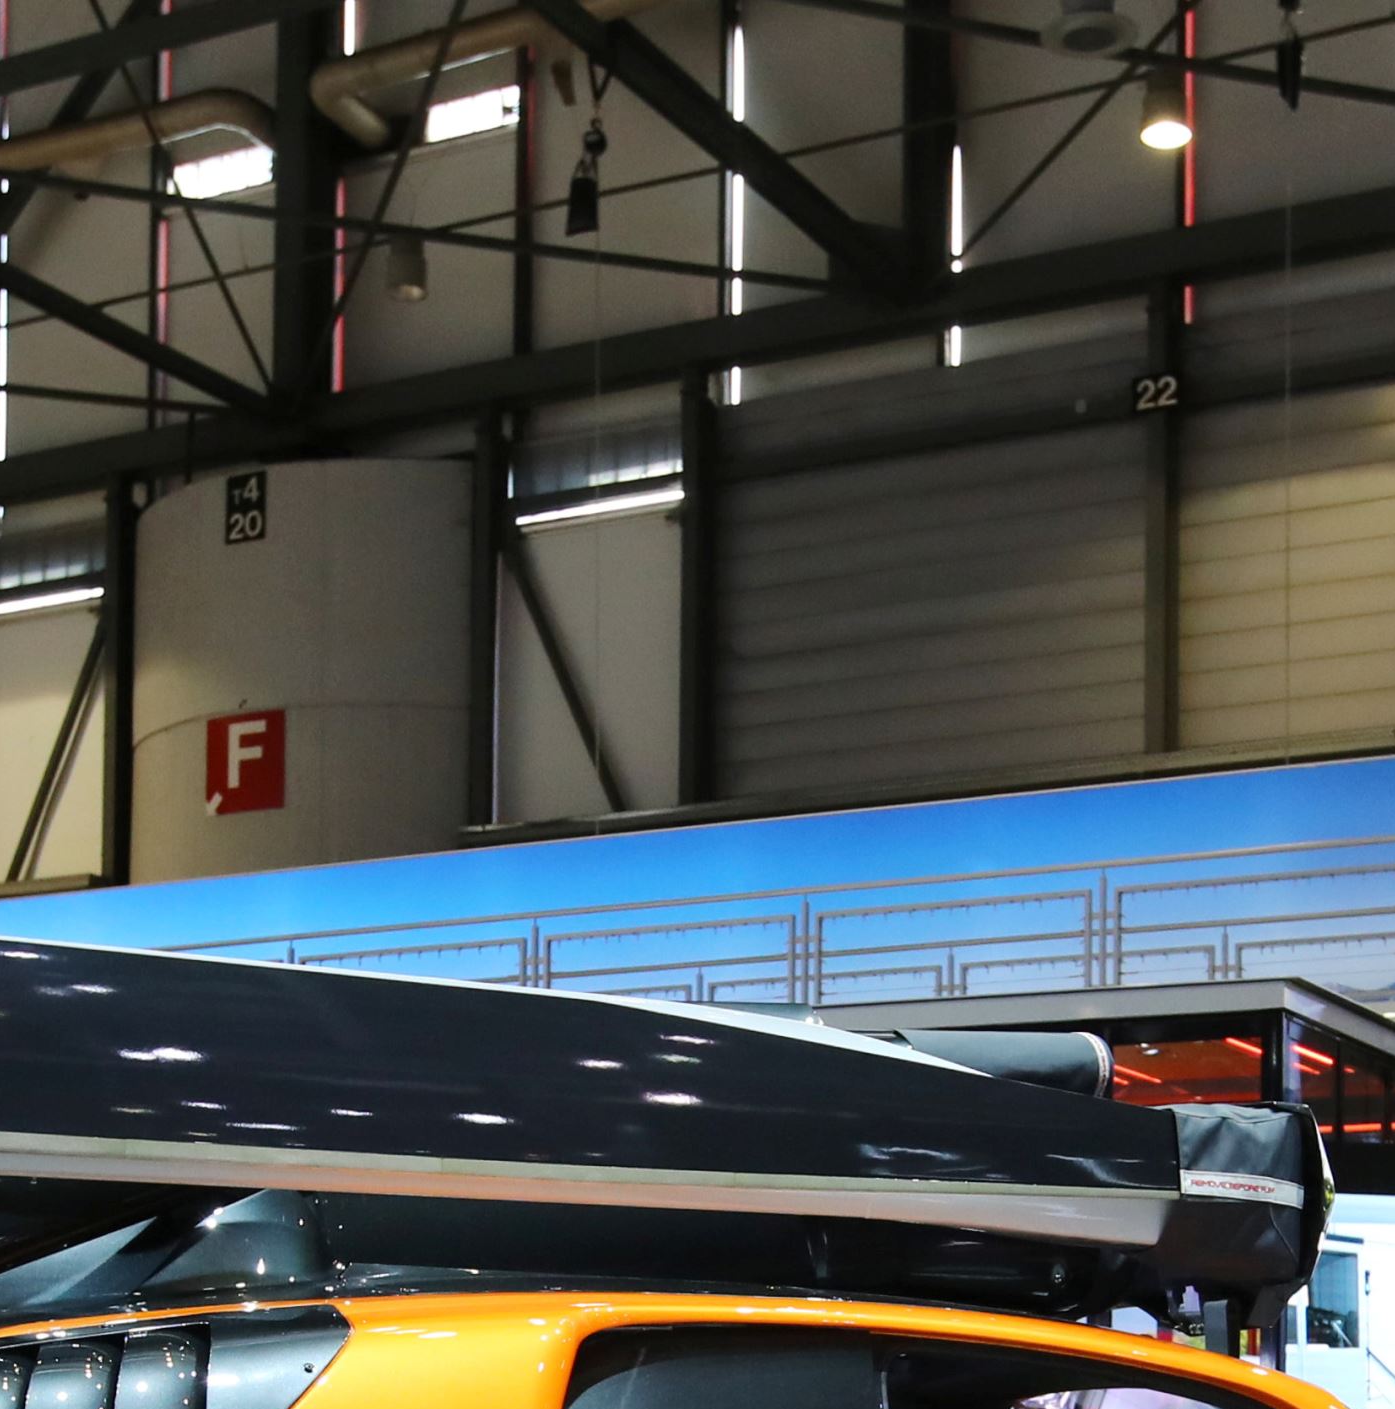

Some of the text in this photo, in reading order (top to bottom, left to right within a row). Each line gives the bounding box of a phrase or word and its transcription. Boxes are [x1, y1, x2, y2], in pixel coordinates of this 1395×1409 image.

[1135, 376, 1178, 410] 22
[229, 509, 263, 540] 20
[227, 719, 267, 788] F
